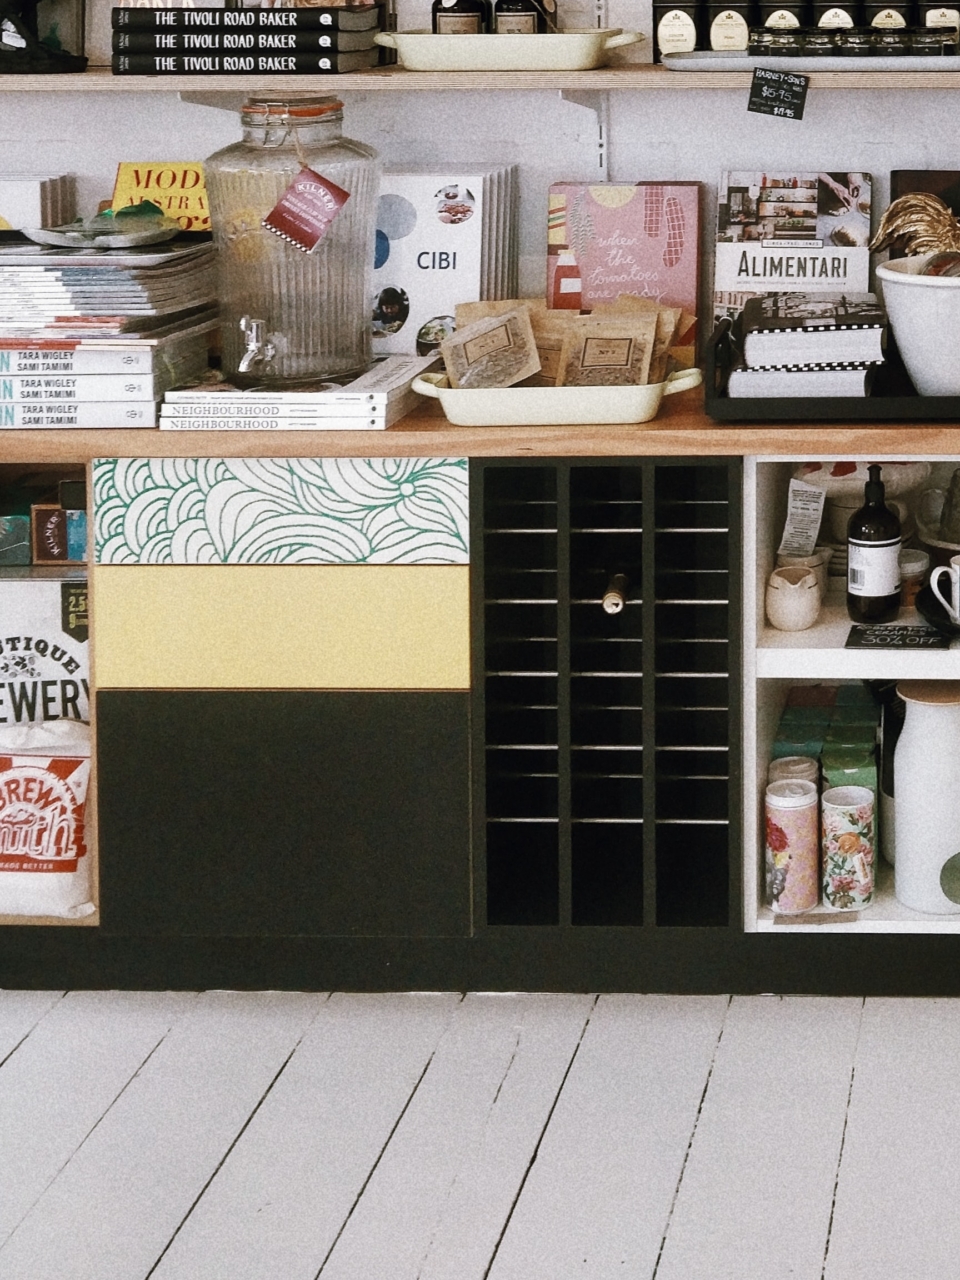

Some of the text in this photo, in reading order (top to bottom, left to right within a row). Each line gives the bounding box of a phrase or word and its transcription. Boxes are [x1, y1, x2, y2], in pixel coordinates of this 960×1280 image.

[154, 11, 297, 26] THE TIVOLI ROAD BAKER
[154, 34, 297, 48] THE TIVOLI ROAD BAKER
[154, 56, 297, 71] THE TIVOLI ROAD BAKER
[297, 183, 336, 210] KILNER
[597, 230, 640, 246] when
[417, 251, 457, 270] CIBI
[605, 247, 637, 266] the
[737, 250, 848, 278] ALIMENTARI
[586, 267, 659, 284] tomatoes
[586, 286, 666, 302] are ready
[18, 351, 74, 360] TARA WIGLEY
[17, 362, 73, 371] SAMI TAMIMI
[20, 379, 77, 388] TARA WIGLEY
[20, 390, 76, 399] SAMI TAMIMI
[22, 405, 78, 414] TARA WIGLEY
[172, 407, 280, 415] NEIGHBOURHOOD
[21, 416, 77, 426] SAMI TAMIMI
[170, 420, 279, 429] NEIGHBOURHOOD
[45, 516, 61, 555] KILNER
[861, 635, 942, 645] 30% OFF
[23, 862, 54, 870] BETTER
